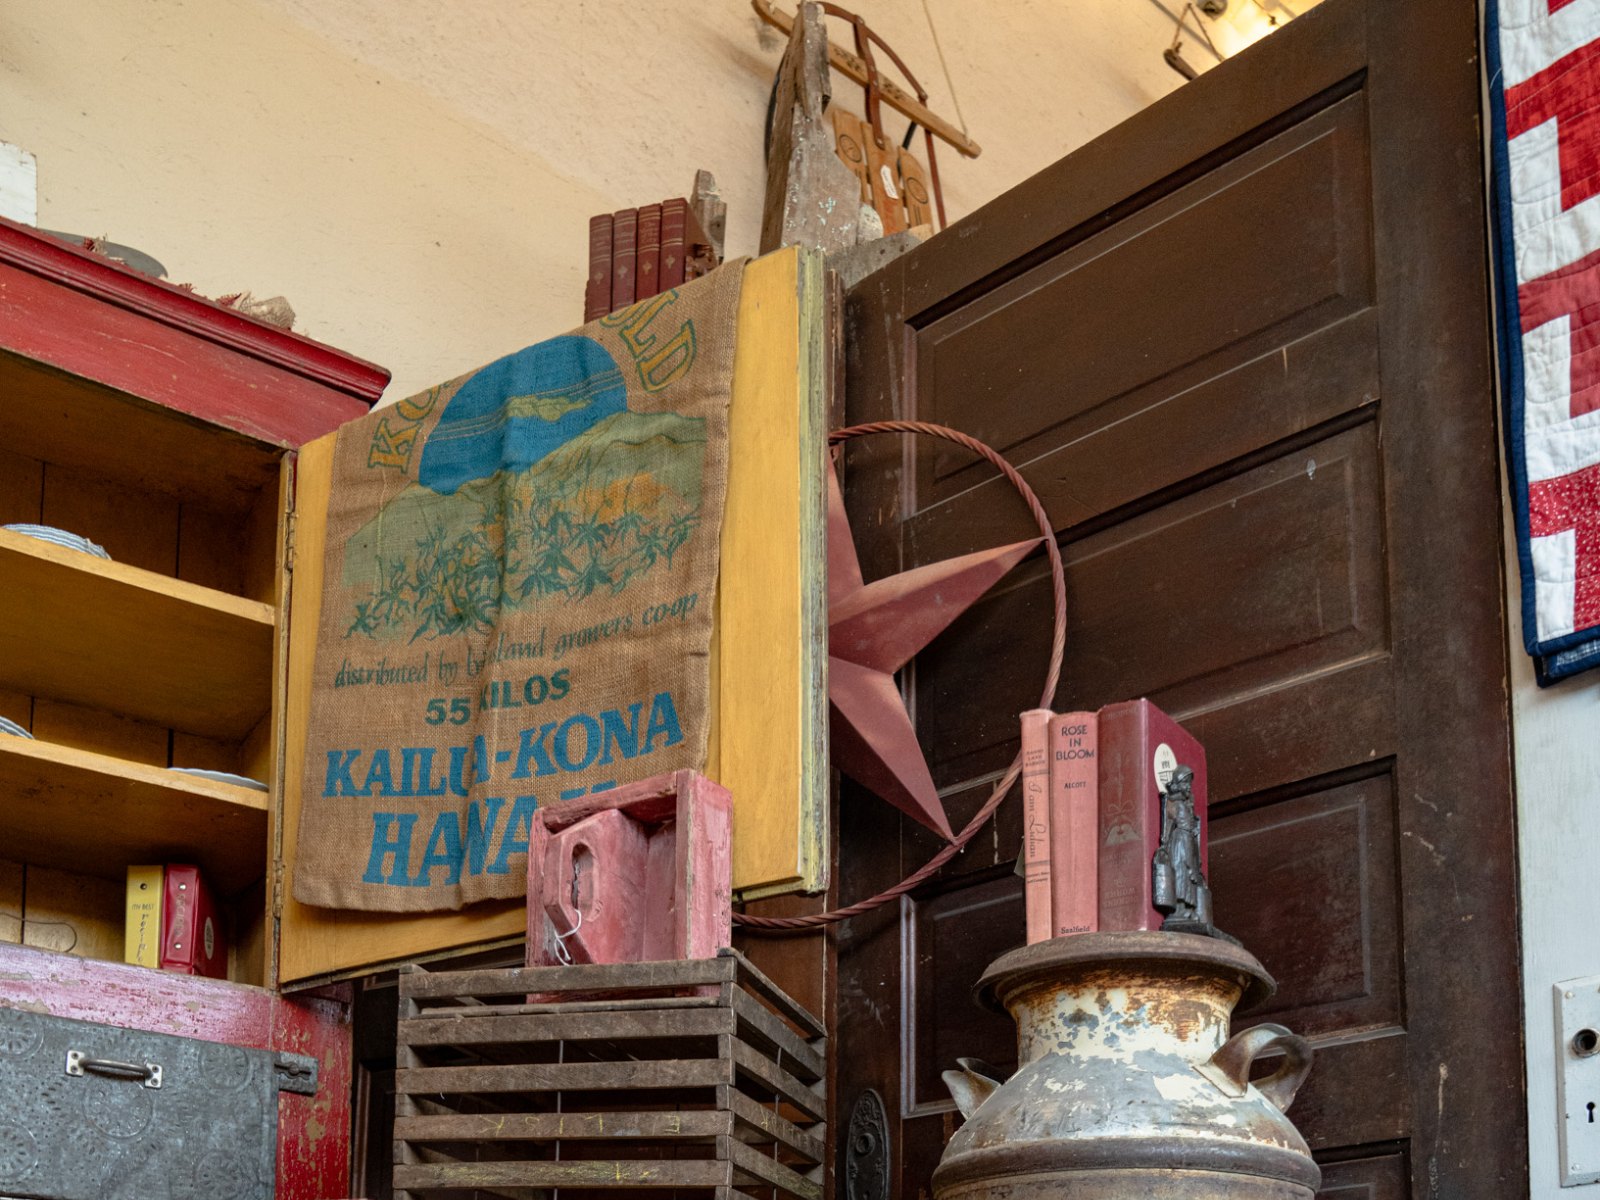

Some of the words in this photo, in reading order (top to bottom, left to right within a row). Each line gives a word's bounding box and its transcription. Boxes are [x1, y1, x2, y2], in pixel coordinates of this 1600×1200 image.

[334, 652, 429, 688] distributed
[438, 649, 458, 688] by
[552, 614, 632, 661] growers
[425, 696, 471, 726] 55
[1061, 725, 1088, 736] ROSE
[1069, 738, 1081, 748] IN
[1056, 749, 1095, 760] BLOOM
[362, 781, 617, 888] HAWA
